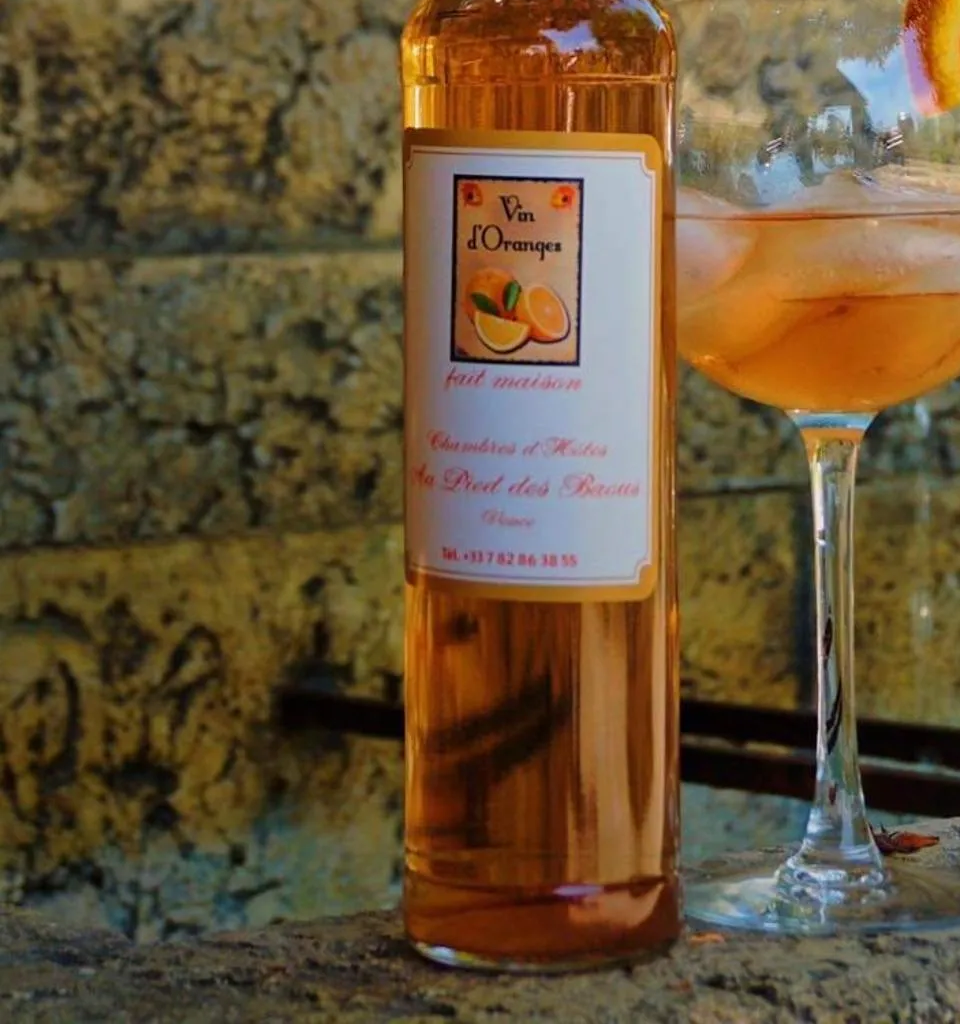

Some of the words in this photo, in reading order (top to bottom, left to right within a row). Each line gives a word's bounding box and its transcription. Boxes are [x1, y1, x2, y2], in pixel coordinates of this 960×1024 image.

[500, 194, 535, 223] Vin
[467, 225, 562, 260] d'Oranges
[445, 367, 486, 392] fait
[494, 372, 583, 391] maison
[427, 430, 516, 456] Chambres
[507, 476, 549, 498] des
